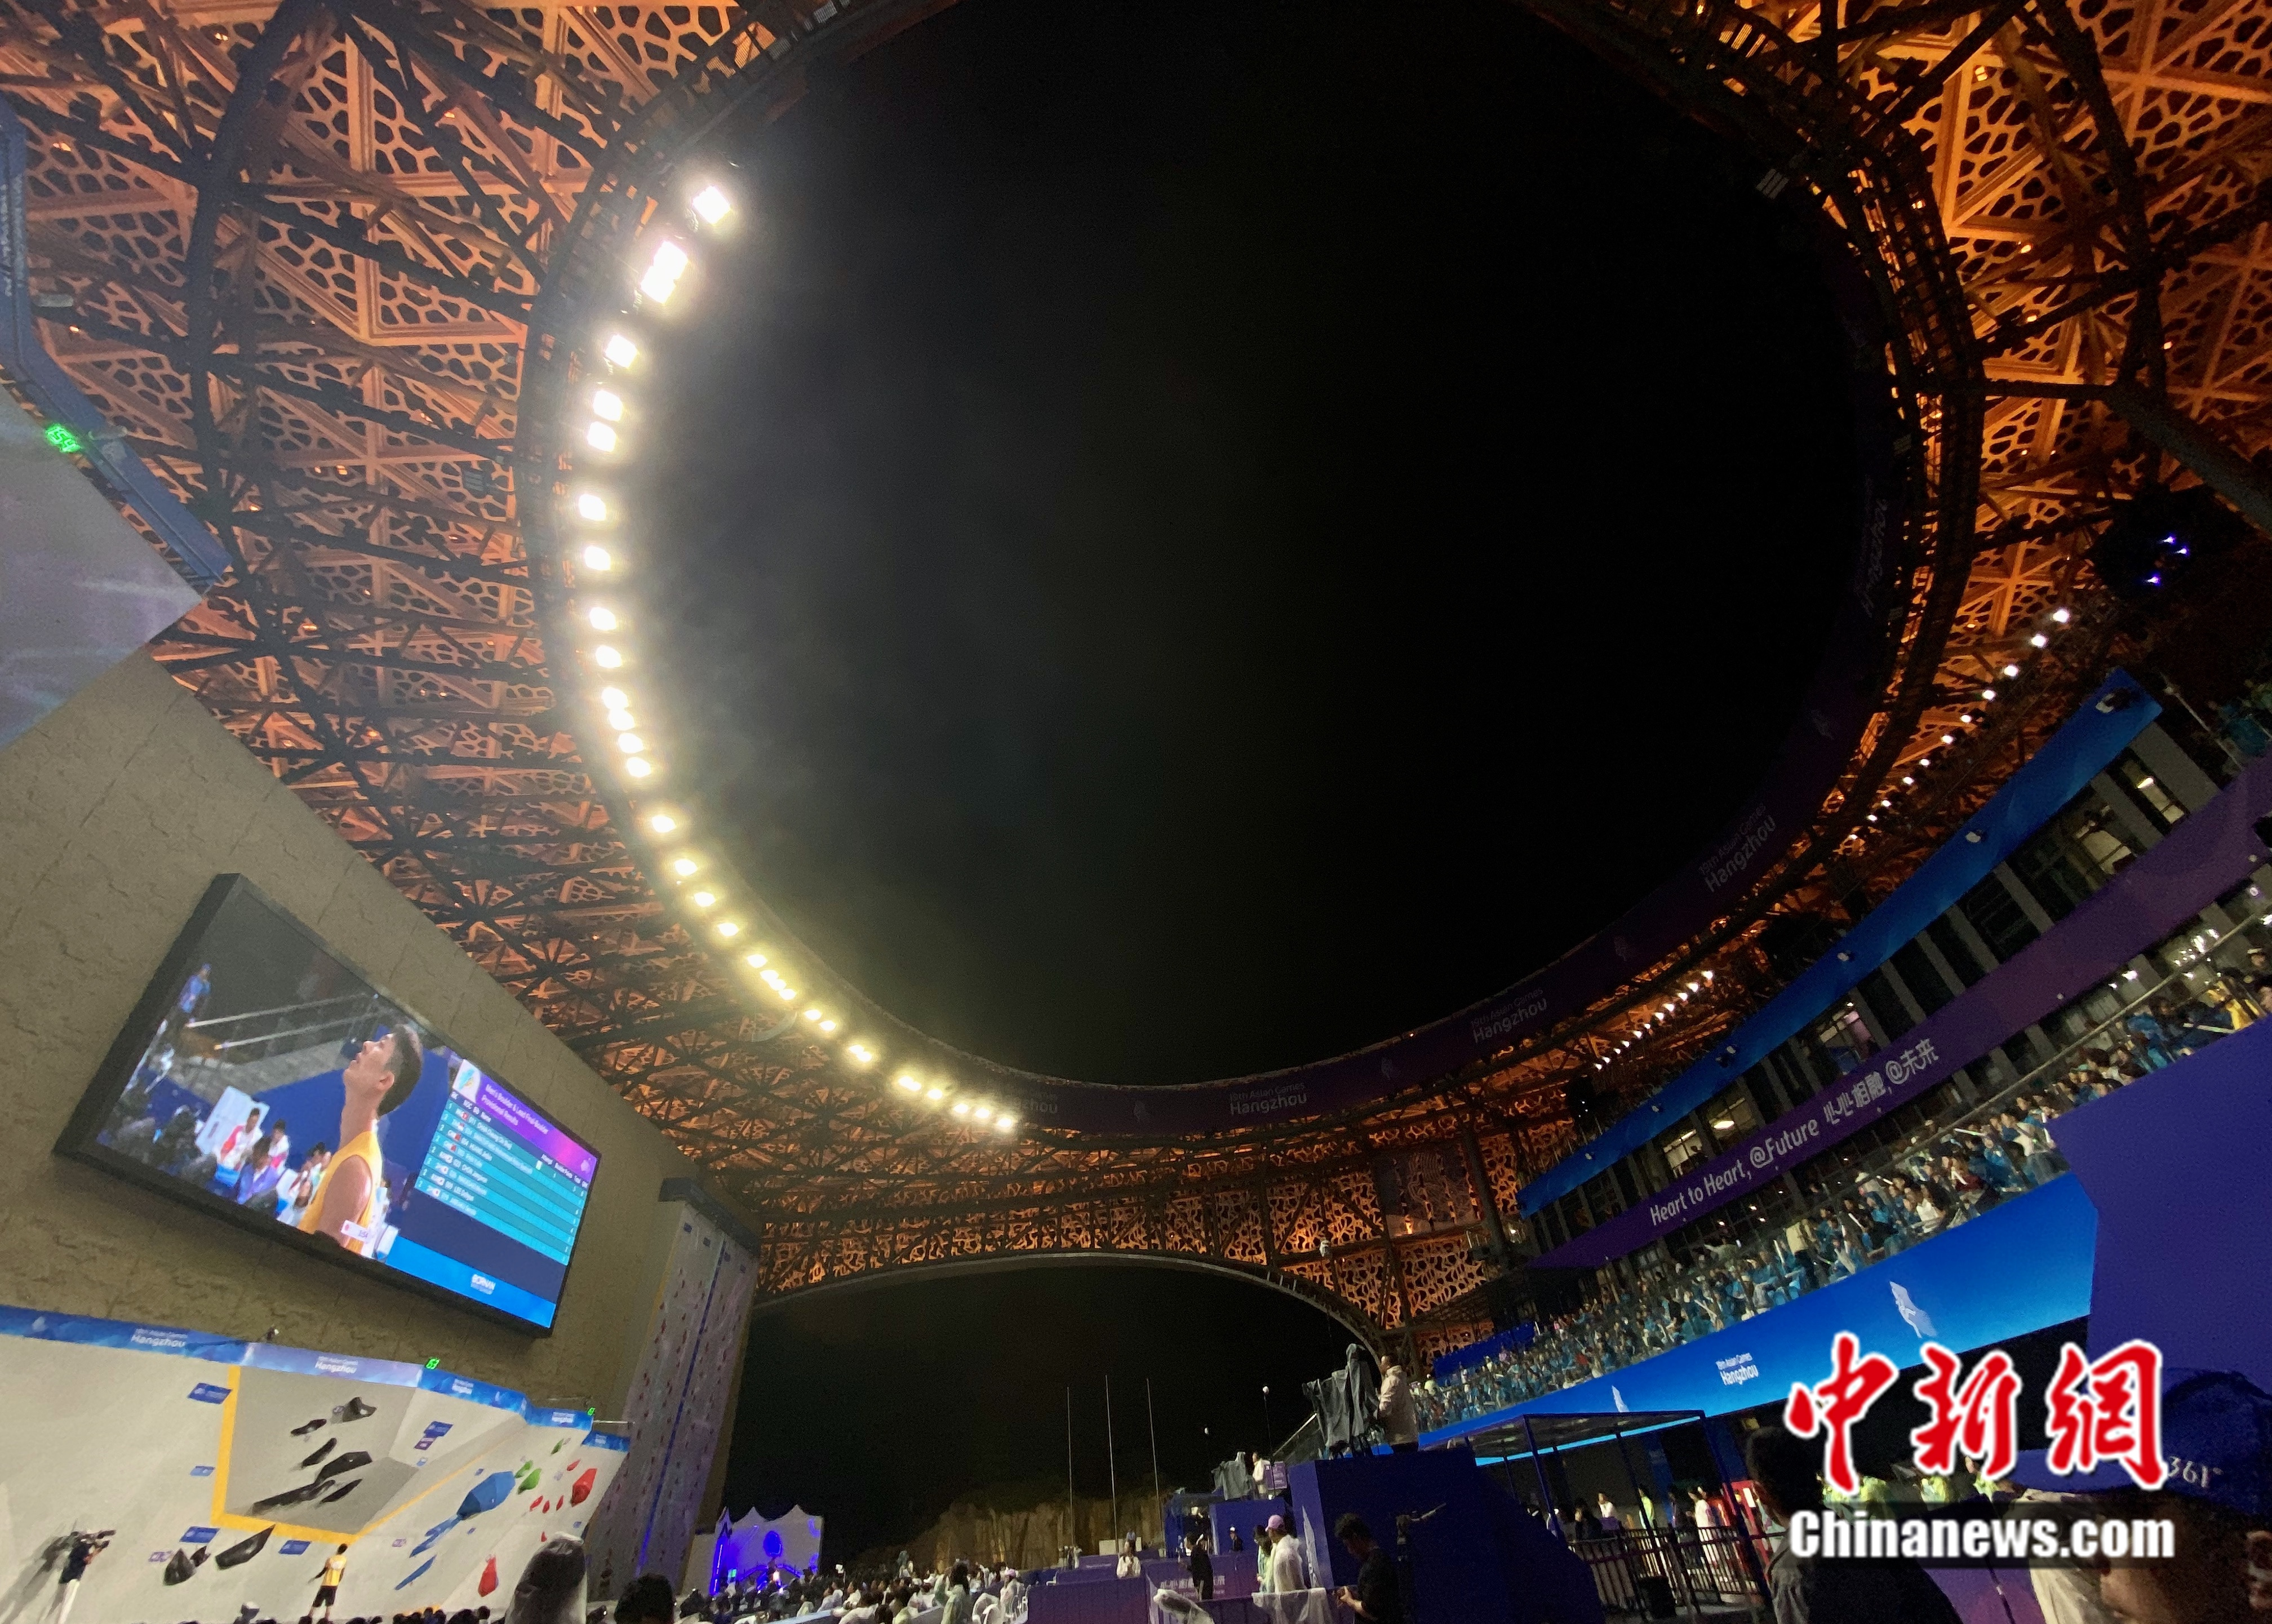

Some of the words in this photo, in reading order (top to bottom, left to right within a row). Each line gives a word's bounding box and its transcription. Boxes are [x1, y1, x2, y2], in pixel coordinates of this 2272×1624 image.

[1705, 815, 1776, 892] Hangzhou
[1472, 997, 1547, 1043] Hangzhou
[1230, 1093, 1307, 1115] Hangzhou
[1650, 1192, 1688, 1226] Heart
[1688, 1187, 1704, 1205] to
[1703, 1159, 1752, 1196] Heart,
[1750, 1119, 1820, 1168] @Future
[1720, 1364, 1759, 1386] Hangzhou
